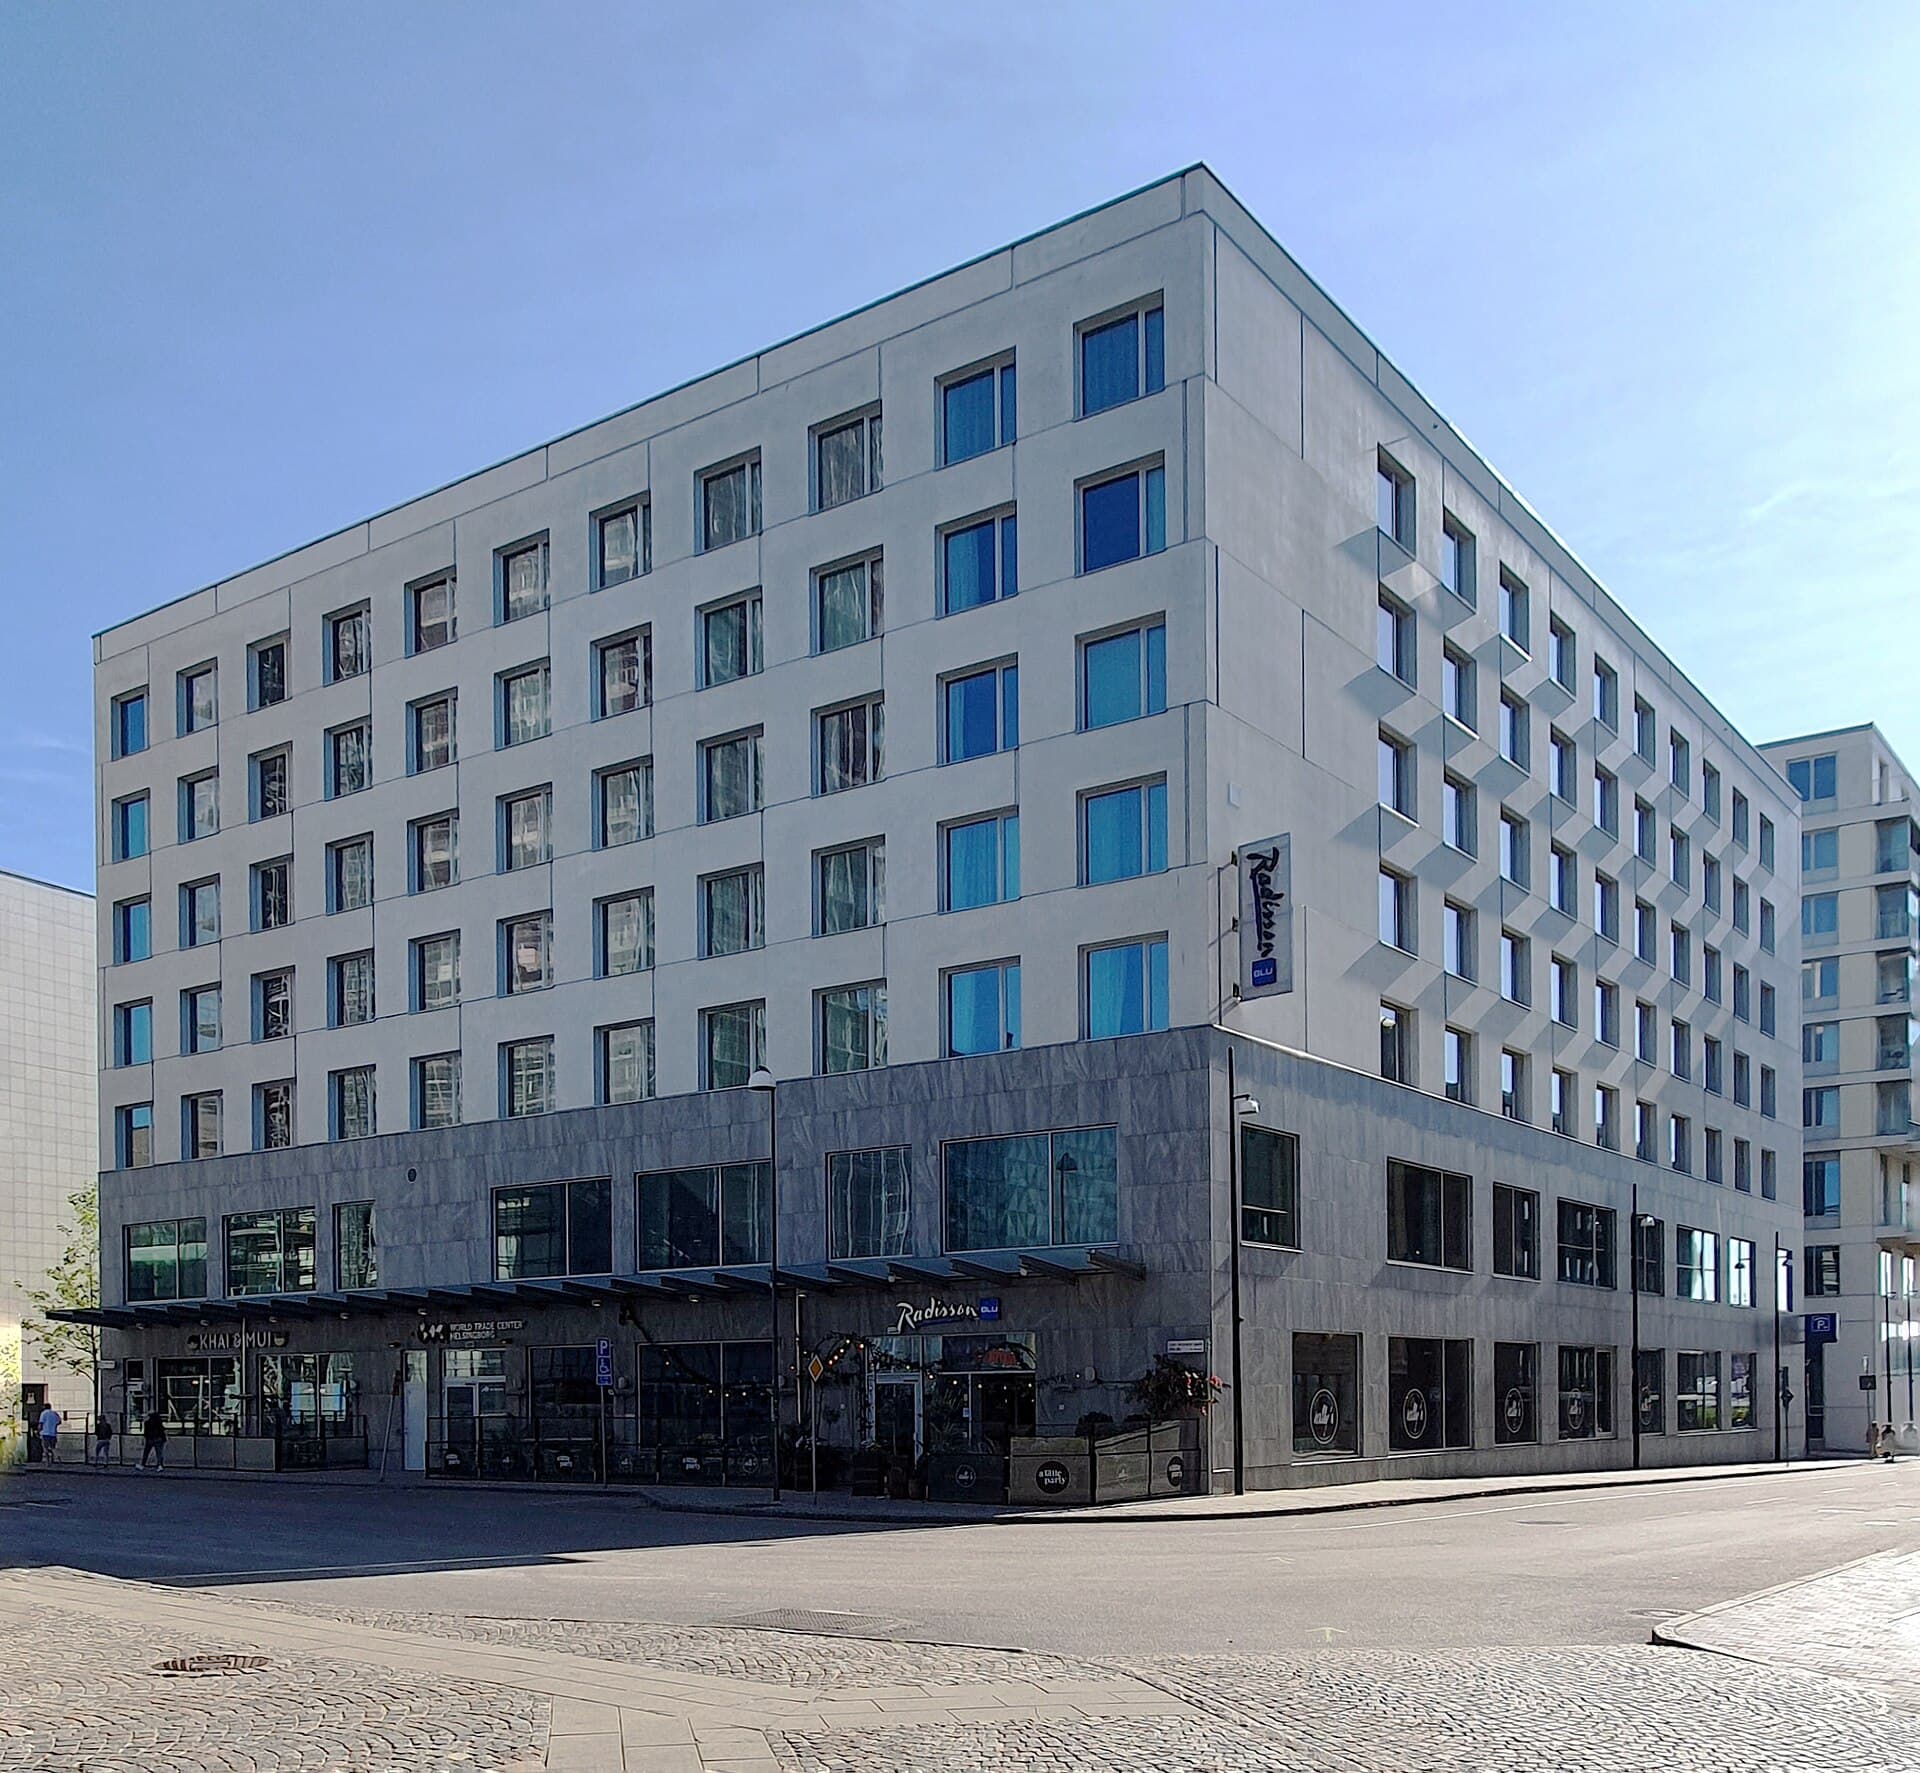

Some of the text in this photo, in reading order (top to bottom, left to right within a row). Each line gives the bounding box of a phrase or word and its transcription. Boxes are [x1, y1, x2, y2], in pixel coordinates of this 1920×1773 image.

[1246, 846, 1285, 958] Radisson
[1253, 967, 1274, 979] BLU
[896, 1296, 999, 1334] Radisson BLU
[450, 1320, 523, 1331] WORLD TRADE CENTER
[1817, 1319, 1826, 1330] P
[199, 1333, 229, 1350] KHAI
[246, 1331, 271, 1348] MUI
[450, 1331, 496, 1341] HELSINGBORG
[600, 1340, 608, 1355] P
